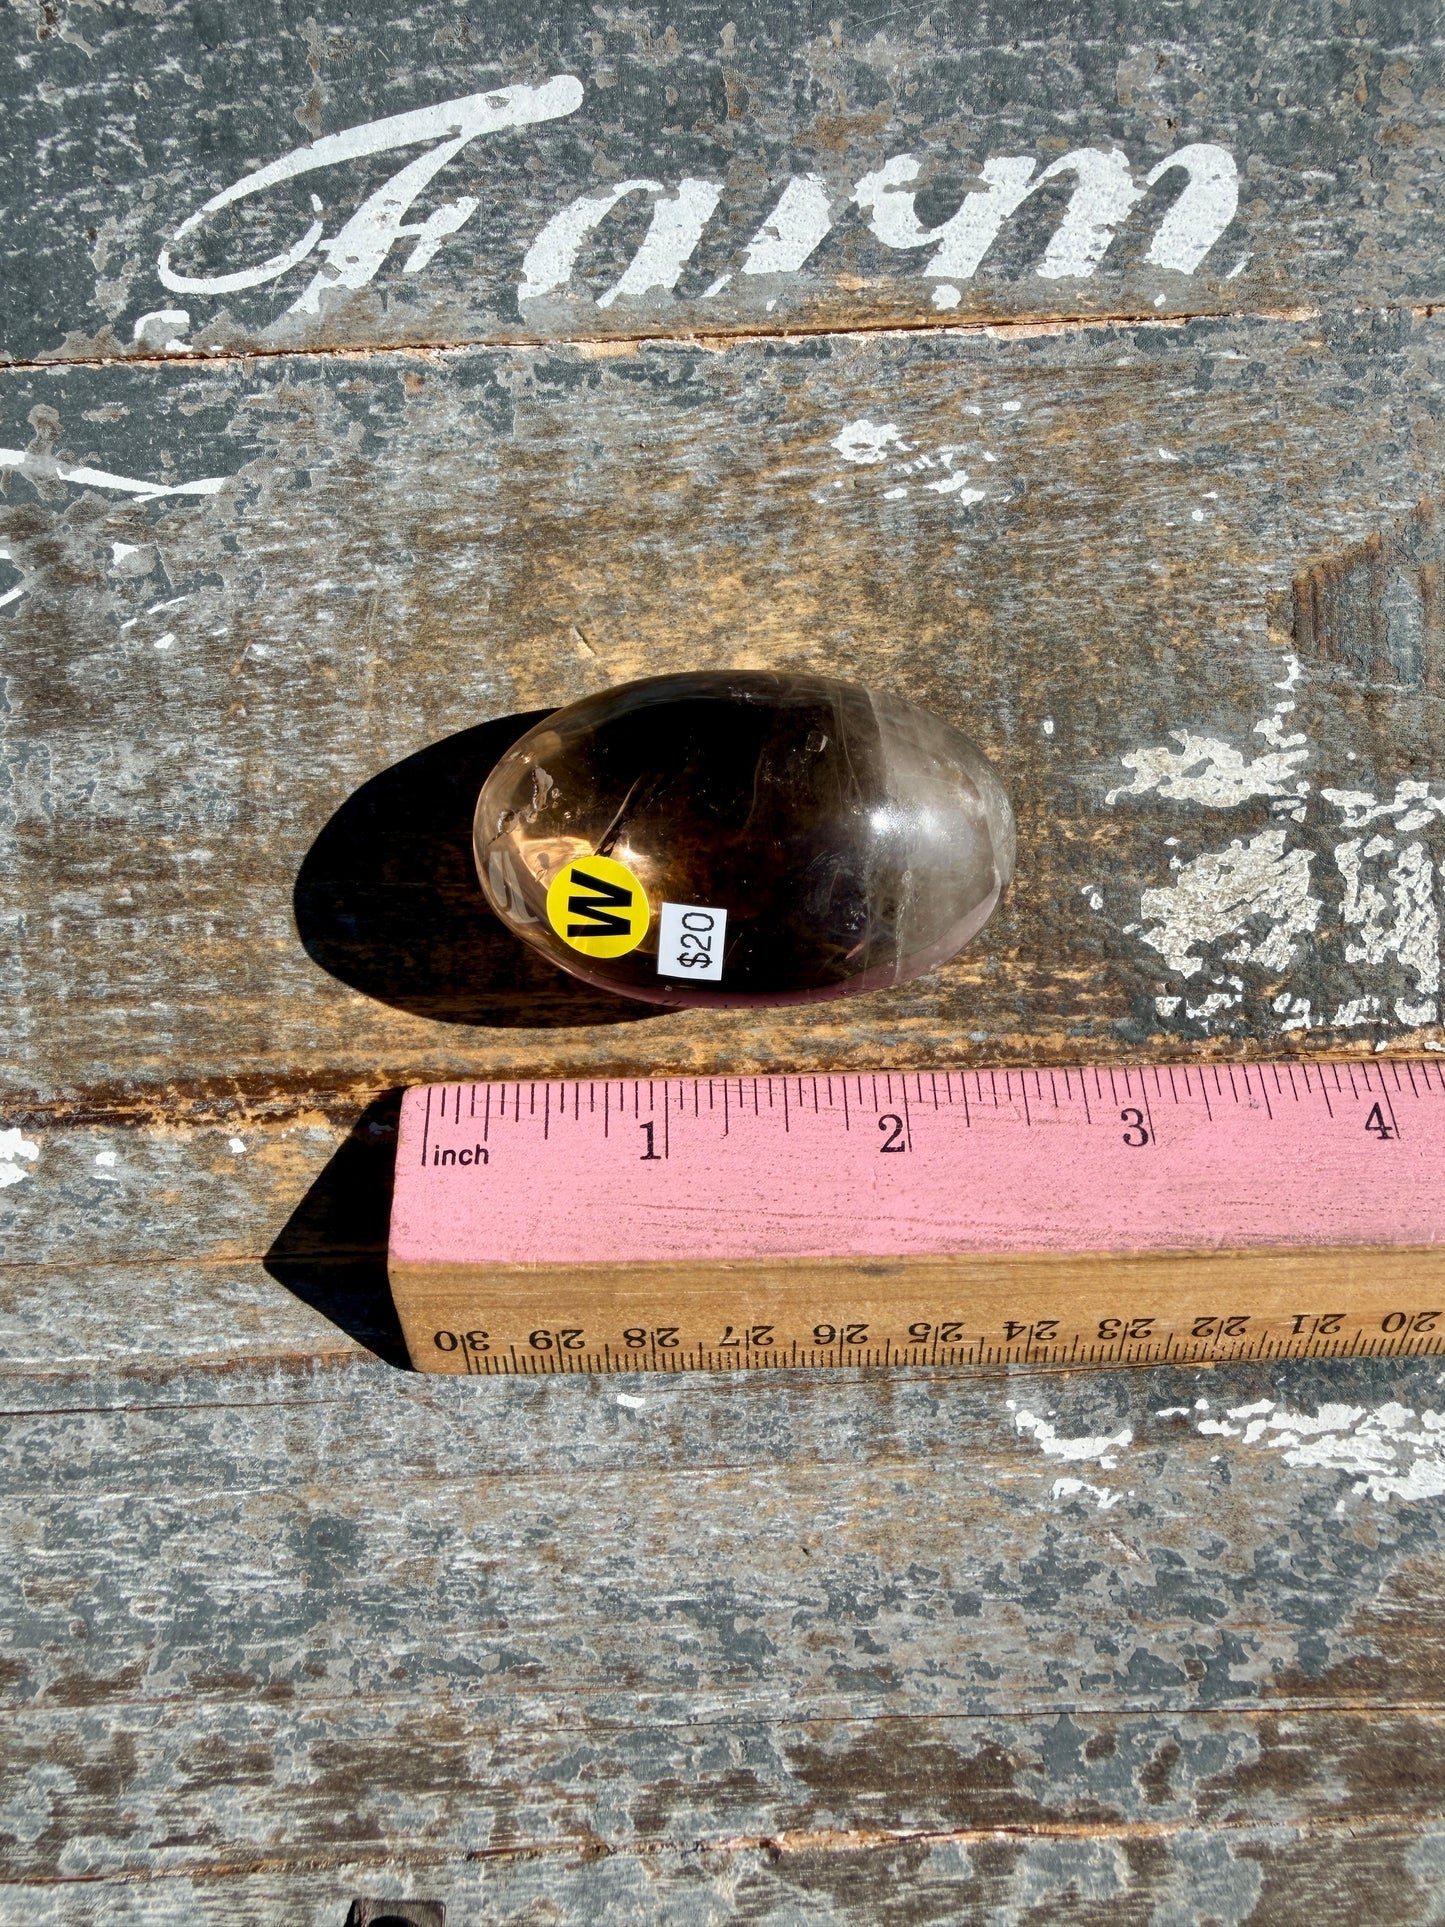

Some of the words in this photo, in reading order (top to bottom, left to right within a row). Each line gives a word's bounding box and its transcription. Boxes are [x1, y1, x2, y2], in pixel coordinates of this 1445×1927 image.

[567, 868, 632, 937] W
[677, 912, 714, 968] $20
[434, 1144, 489, 1166] inch
[640, 1121, 661, 1160] 1
[878, 1114, 905, 1153] 2
[1121, 1108, 1149, 1146] 3
[1364, 1102, 1394, 1140] 4
[908, 1322, 966, 1343] 25
[1002, 1320, 1060, 1341] 24
[1097, 1318, 1155, 1340] 23
[1191, 1316, 1250, 1337] 22
[1291, 1313, 1346, 1335] 21
[1381, 1311, 1443, 1333] 20
[433, 1330, 490, 1351] 30
[529, 1329, 585, 1350] 29
[623, 1327, 680, 1348] 28
[719, 1326, 775, 1346] 27
[813, 1324, 870, 1345] 26
